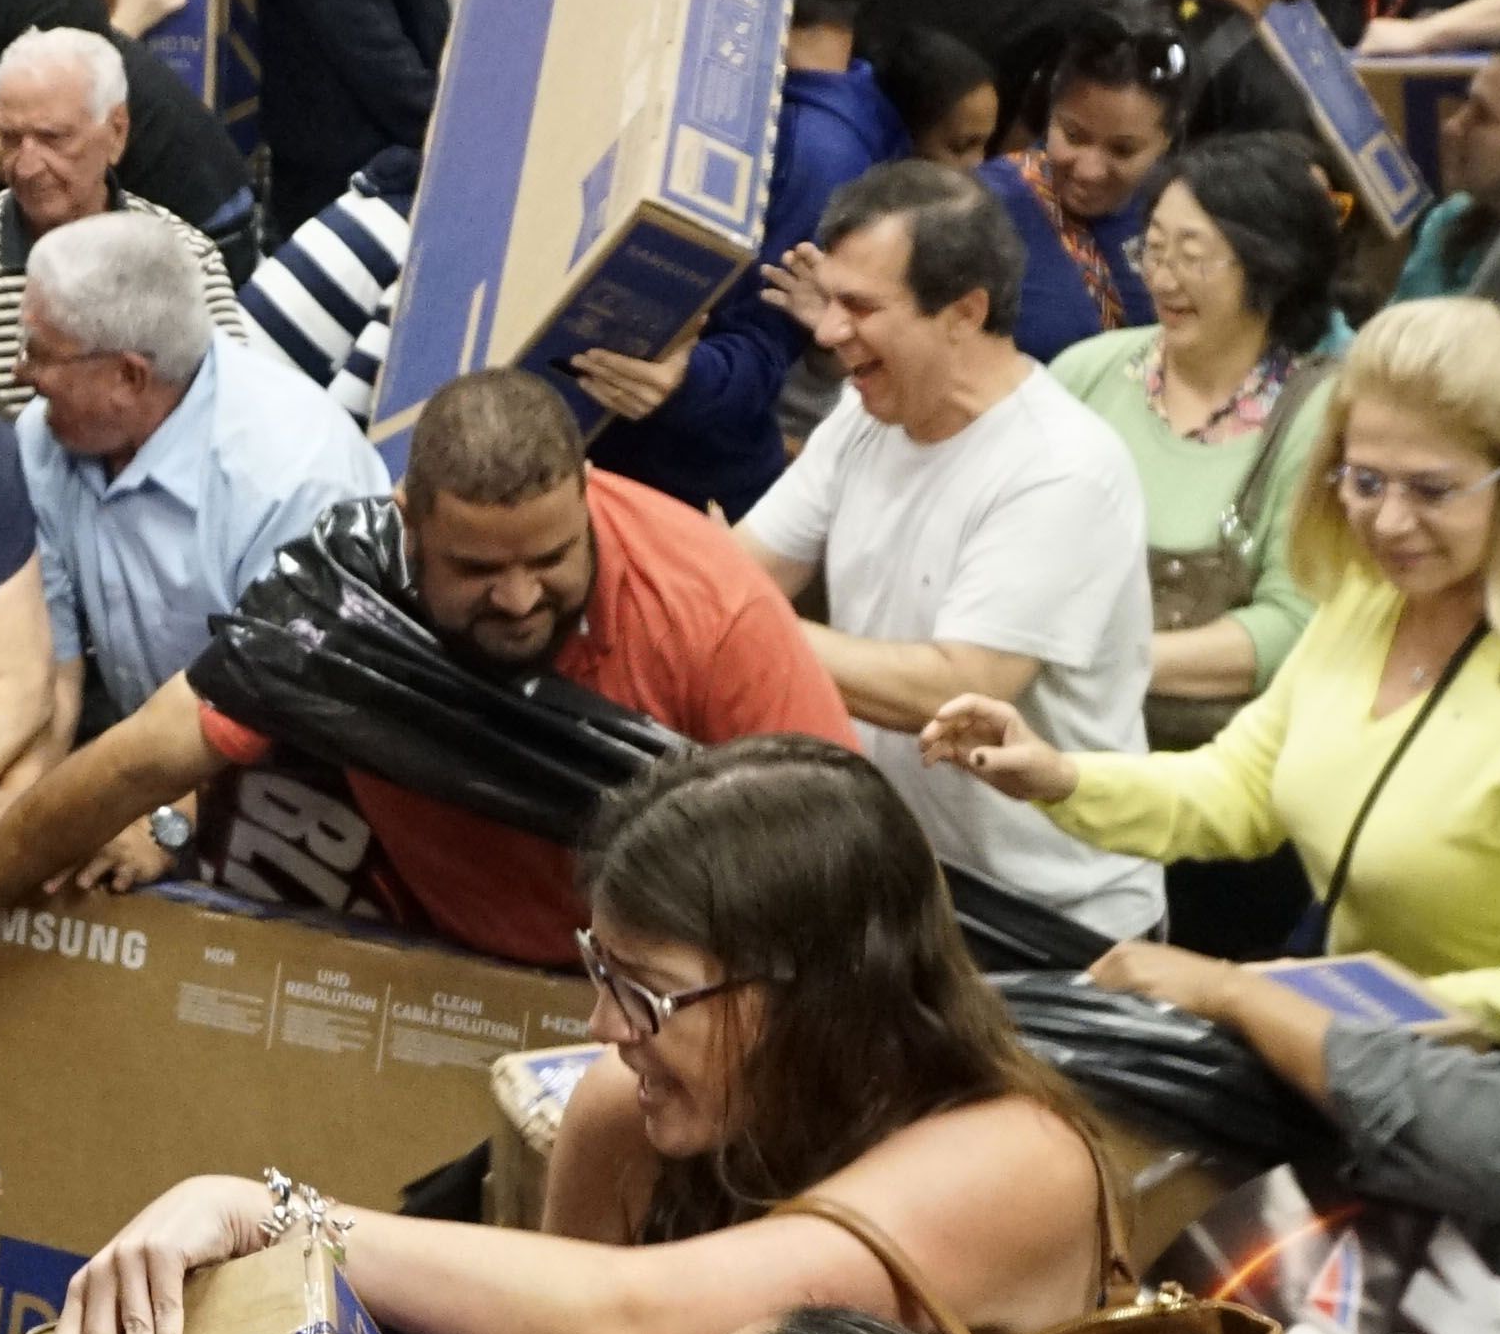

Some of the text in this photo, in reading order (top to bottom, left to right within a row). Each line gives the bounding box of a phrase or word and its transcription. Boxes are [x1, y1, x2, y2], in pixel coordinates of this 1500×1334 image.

[316, 968, 352, 989] UHD
[283, 978, 379, 1015] RESOLUTION
[431, 990, 484, 1016] CLEAN
[390, 1001, 439, 1029] CABLE
[440, 1010, 522, 1044] SOLUTION
